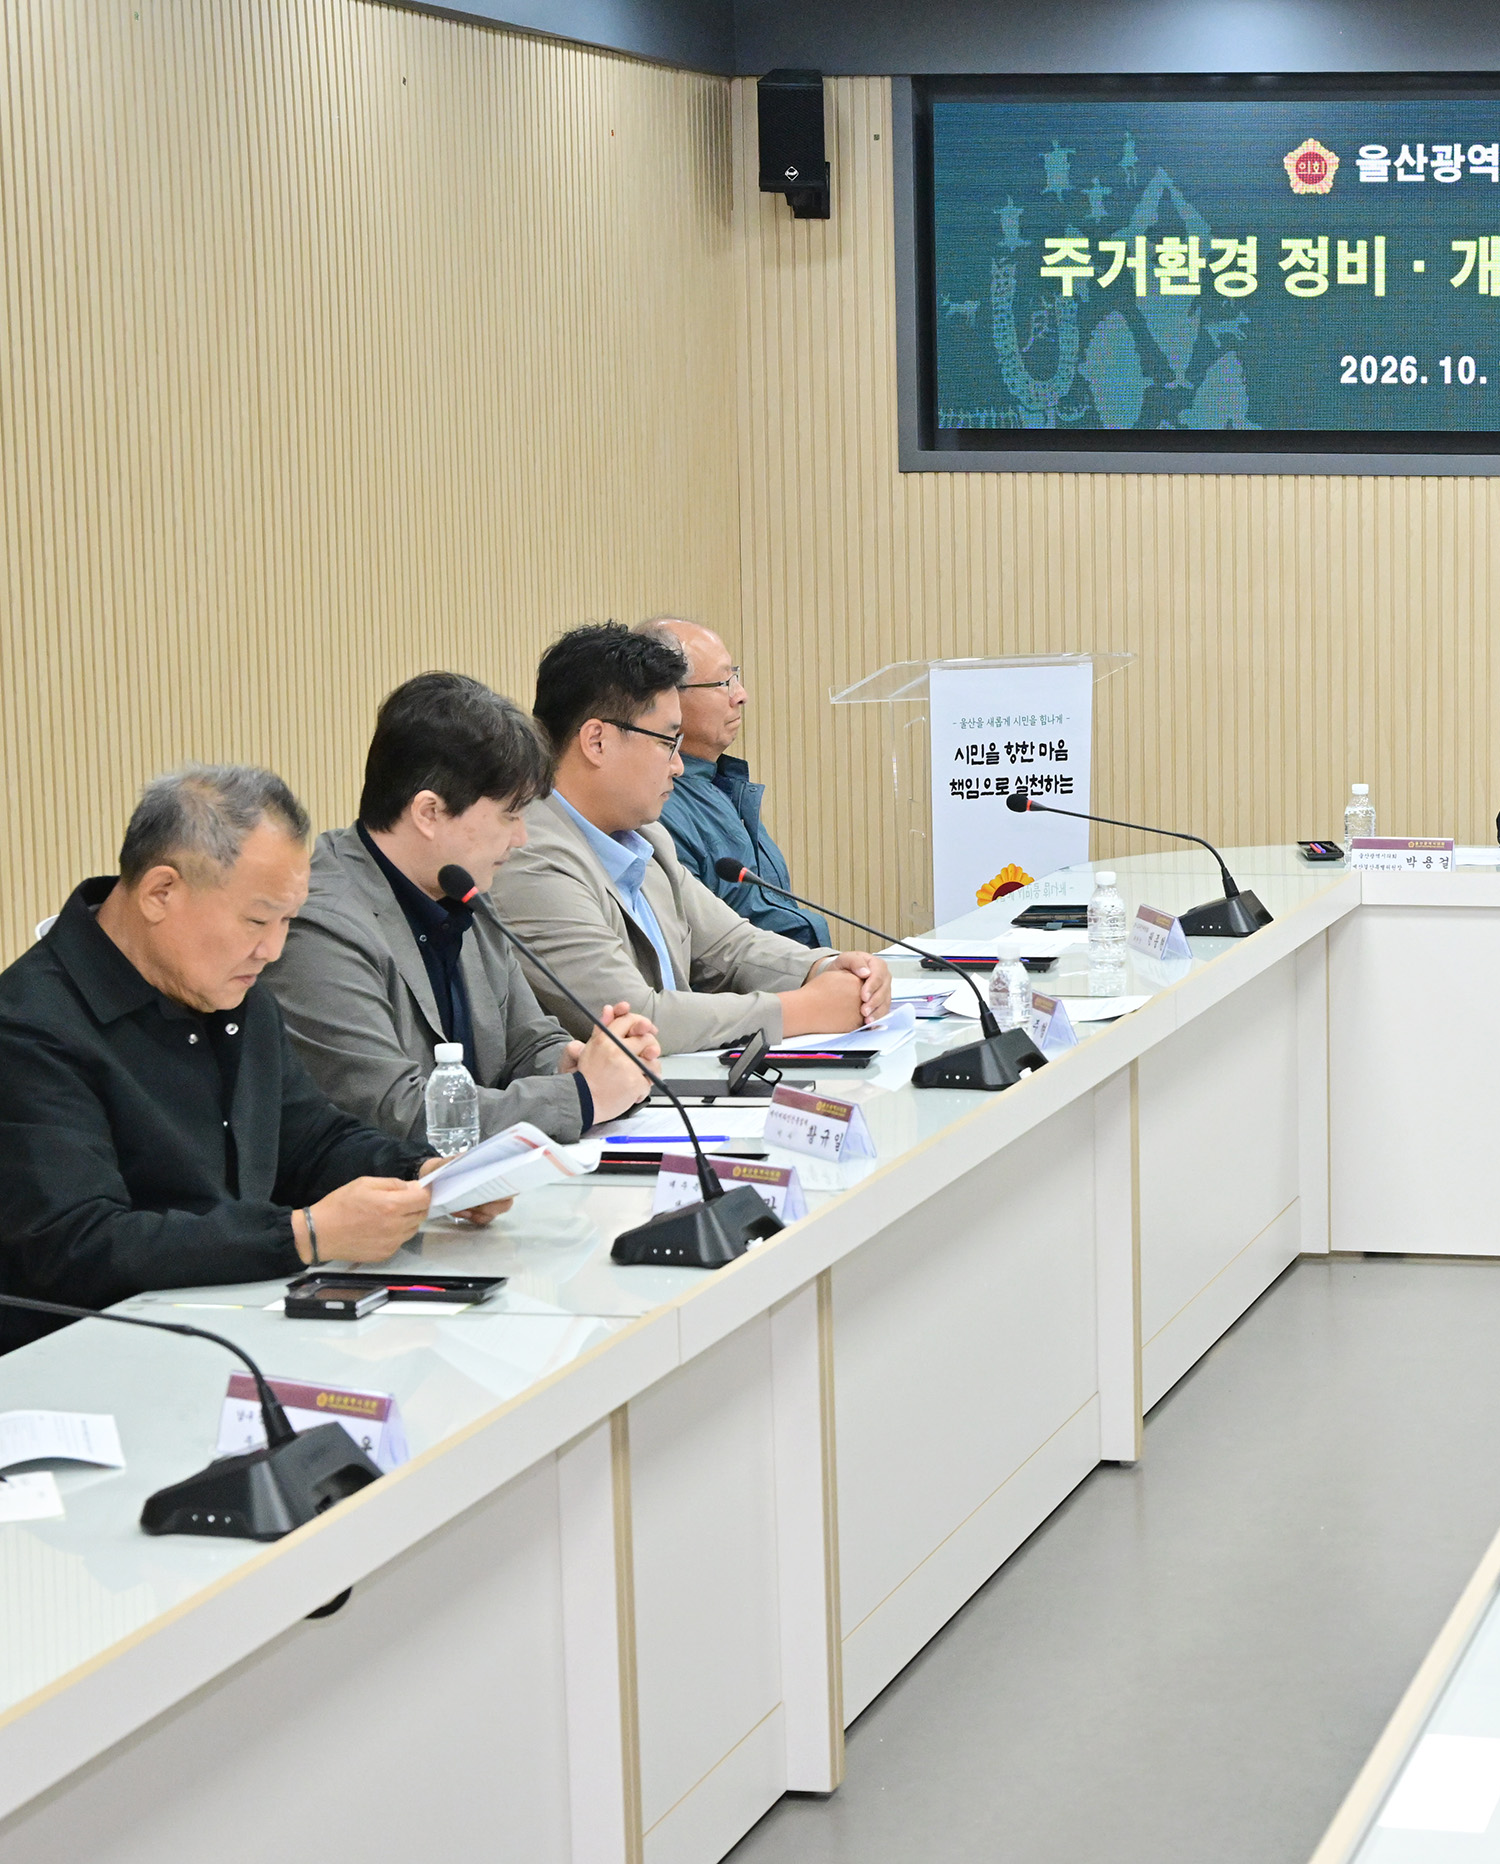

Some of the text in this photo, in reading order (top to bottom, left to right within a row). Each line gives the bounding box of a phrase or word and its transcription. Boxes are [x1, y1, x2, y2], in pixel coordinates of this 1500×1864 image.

[1297, 160, 1326, 175] 의회
[1040, 235, 1259, 299] 주거환경
[1279, 235, 1387, 298] 정비
[1340, 356, 1429, 386] 2026.
[1440, 356, 1488, 386] 10.
[959, 717, 985, 730] 울산을
[986, 716, 1011, 728] 새롭게
[1013, 715, 1038, 727] 시민을
[1039, 714, 1063, 726] 힘나게
[954, 739, 1069, 765] 시민을 향한 마음
[949, 774, 1074, 800] 책임으로 실천하는
[1406, 855, 1450, 870] 박용걸
[806, 1125, 844, 1152] 황규일
